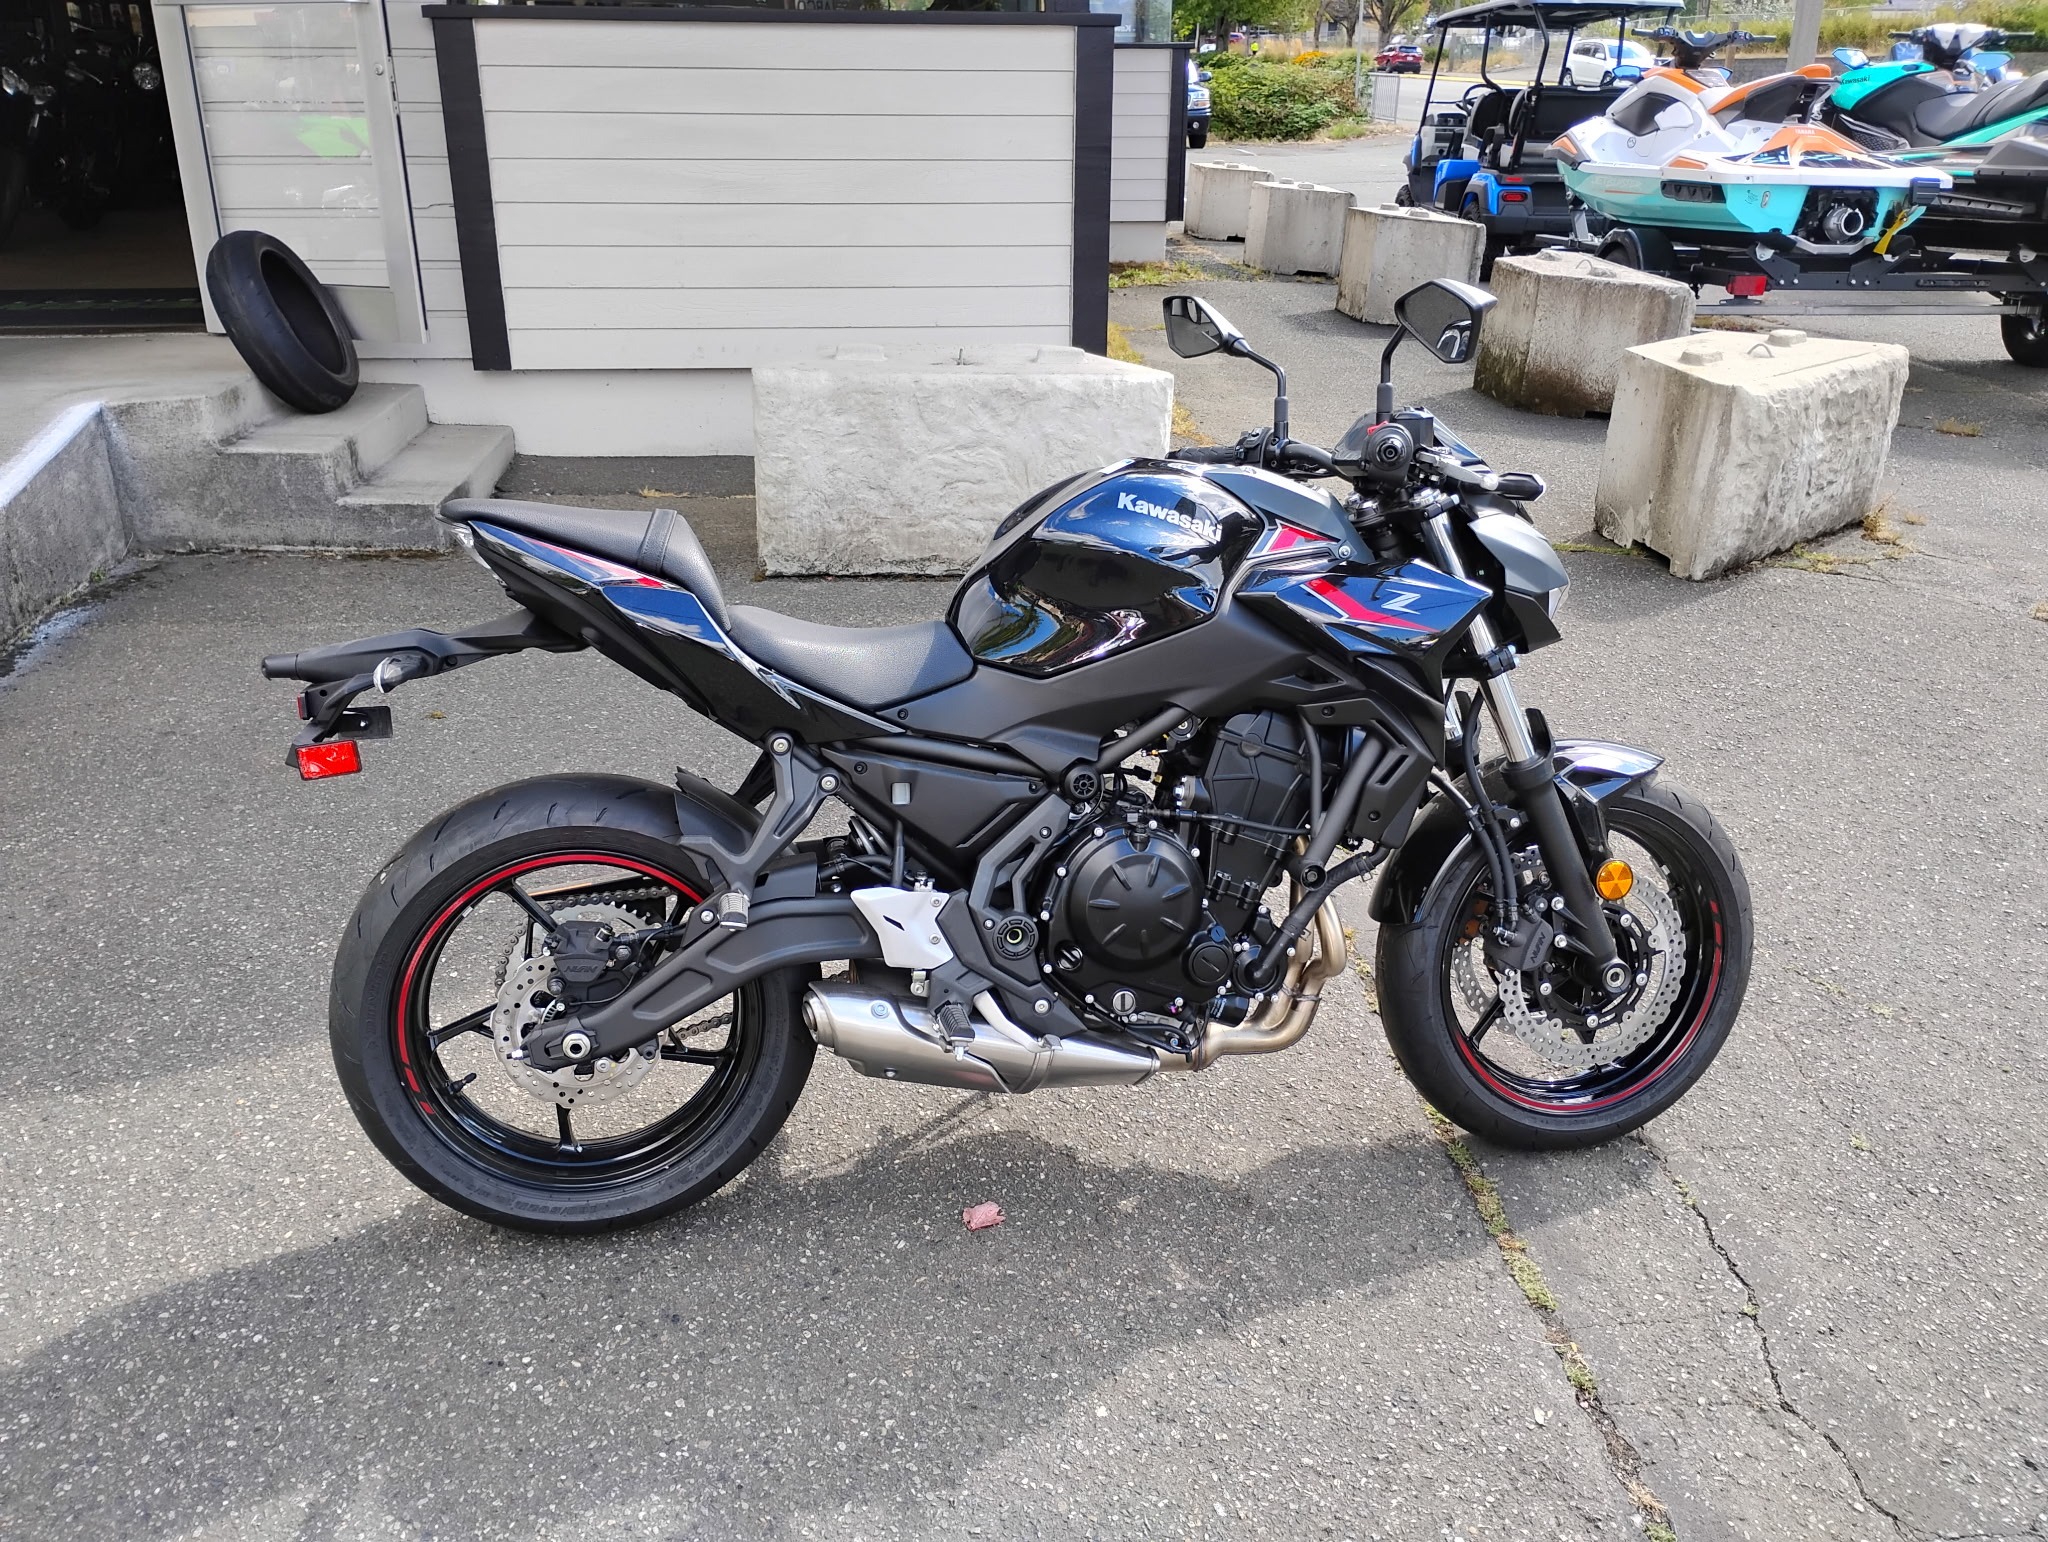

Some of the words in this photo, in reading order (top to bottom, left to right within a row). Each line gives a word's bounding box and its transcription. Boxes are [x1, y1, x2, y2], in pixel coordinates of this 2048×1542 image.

[1841, 74, 1871, 85] Kawasaki
[1117, 492, 1223, 542] Kawasaki
[1381, 589, 1421, 615] Z
